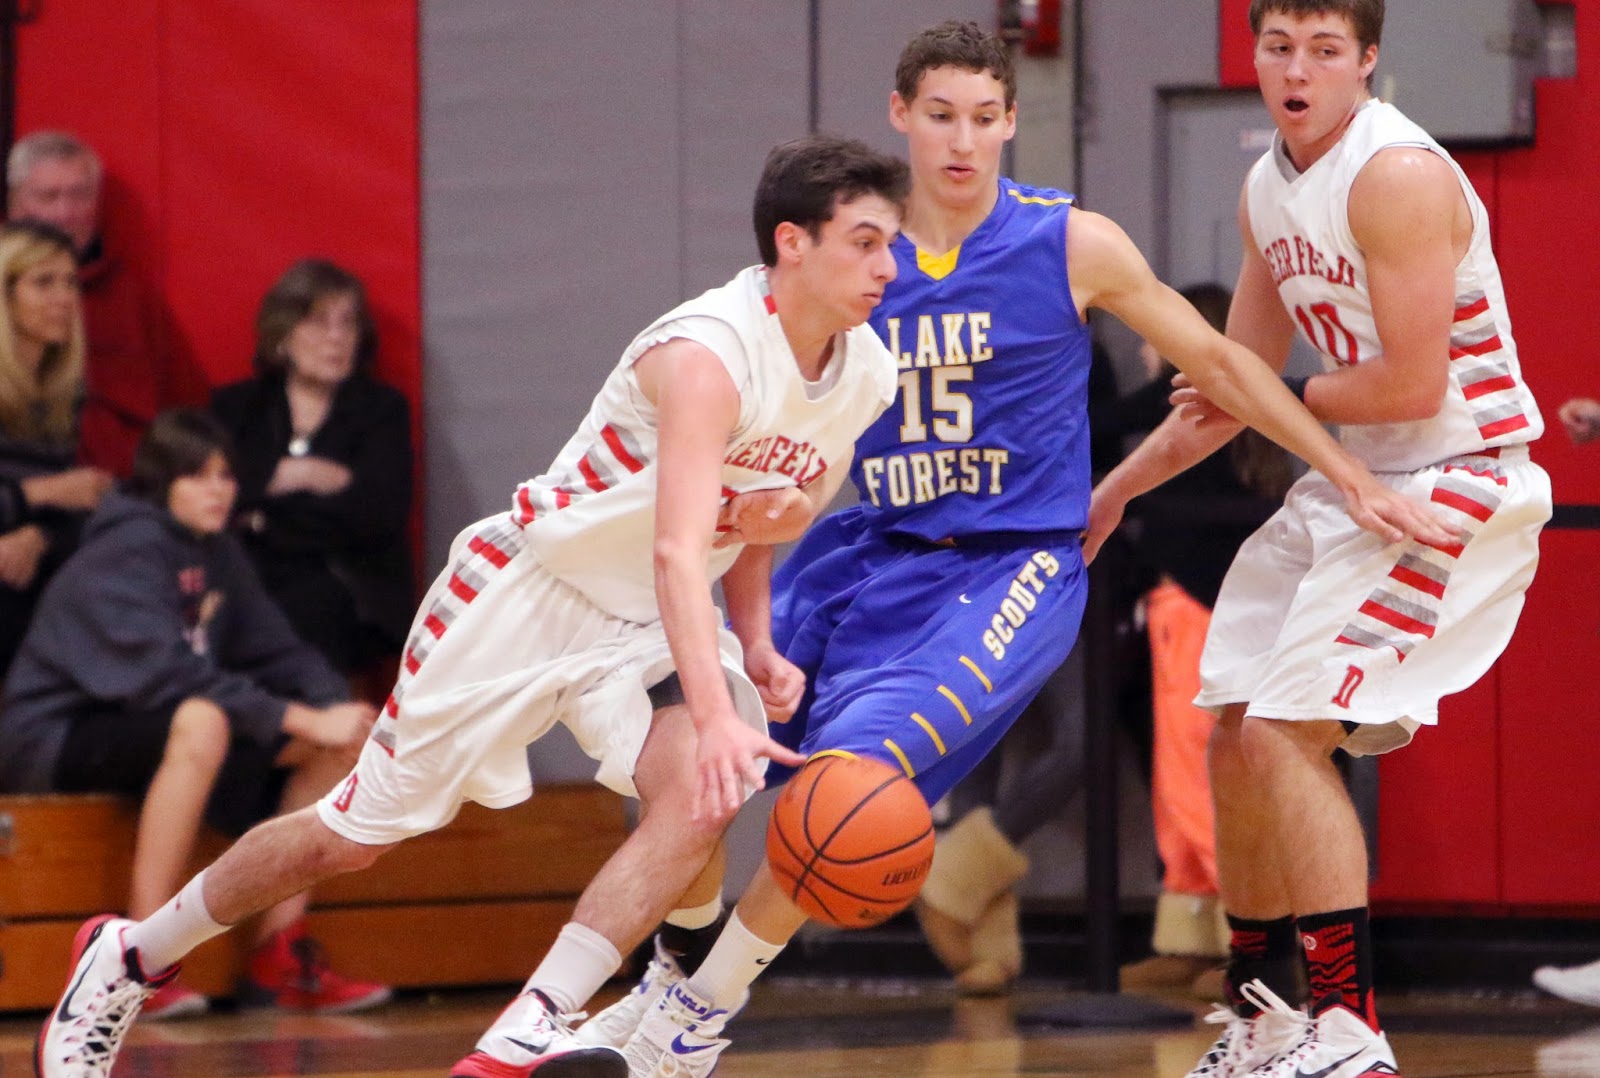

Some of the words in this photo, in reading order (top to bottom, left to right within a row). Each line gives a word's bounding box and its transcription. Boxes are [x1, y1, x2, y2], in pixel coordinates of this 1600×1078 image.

[887, 312, 994, 370] LAKE
[1295, 301, 1358, 366] 10
[898, 365, 974, 443] 15
[862, 448, 1009, 508] FOREST
[982, 550, 1060, 661] SCOUTS
[1330, 664, 1364, 710] D
